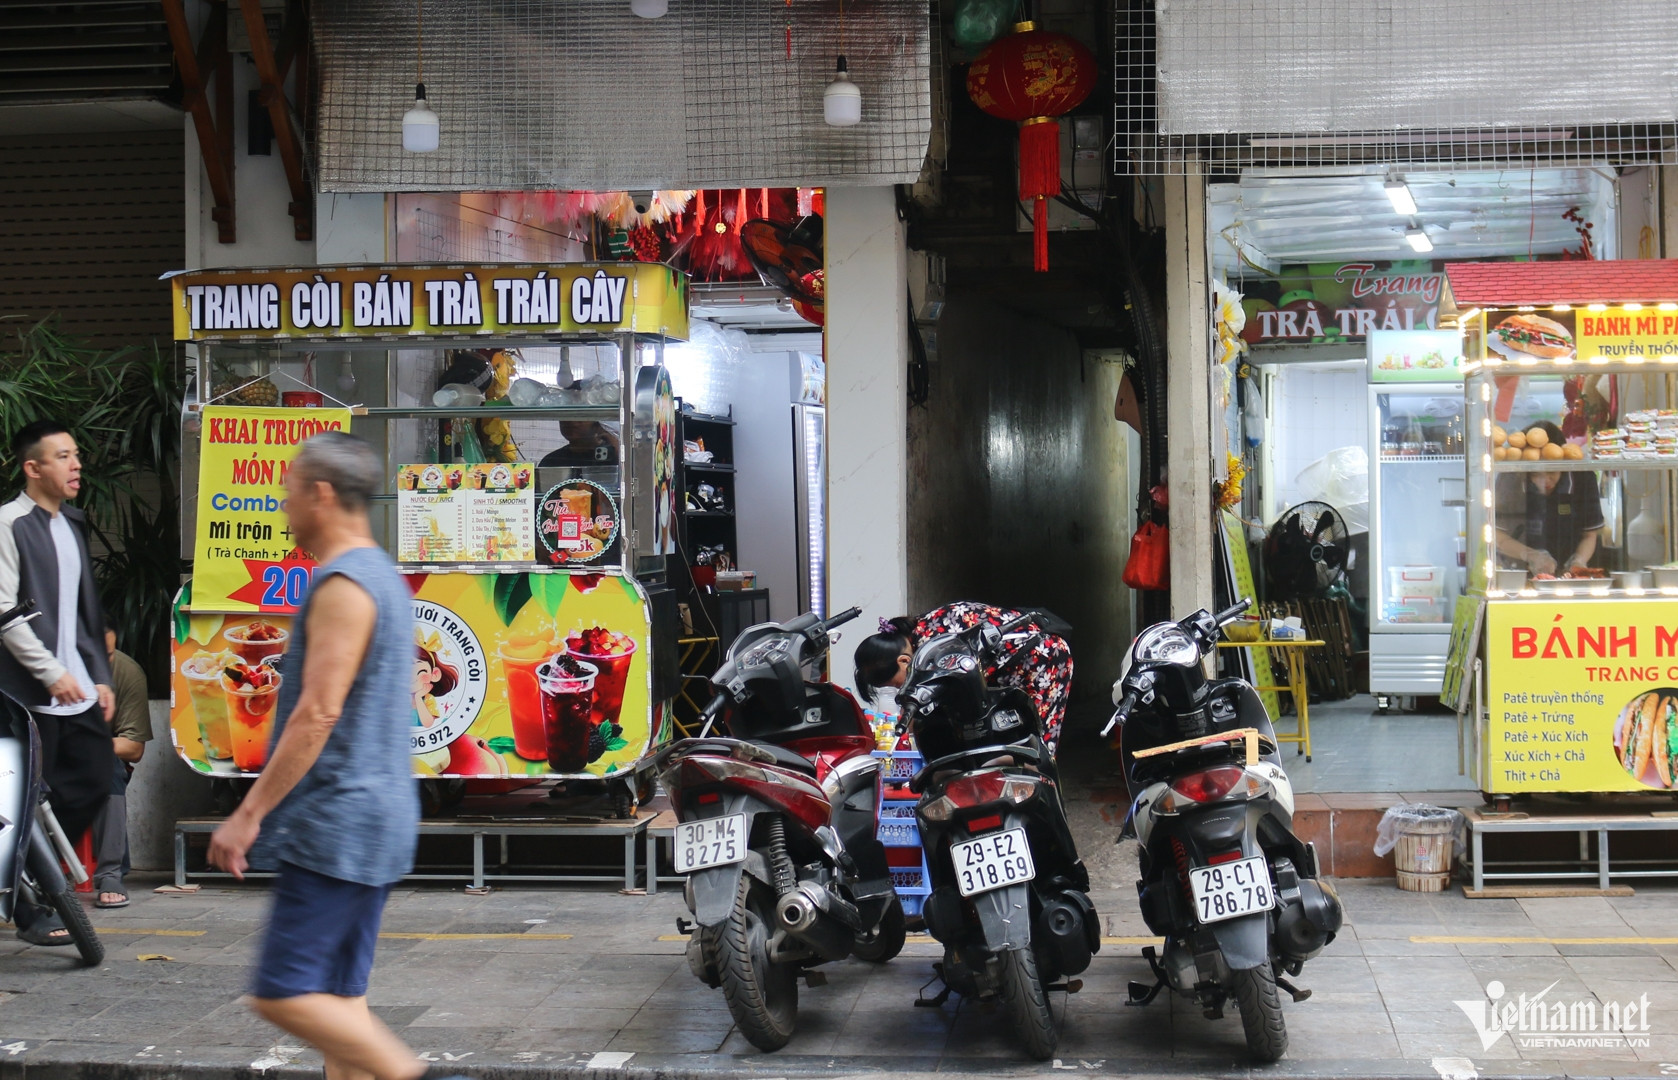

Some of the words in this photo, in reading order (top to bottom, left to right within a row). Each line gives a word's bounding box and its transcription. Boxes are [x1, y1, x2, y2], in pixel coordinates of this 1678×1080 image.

[1335, 263, 1442, 304] Trang
[186, 283, 279, 331] TRANG
[291, 274, 341, 329] CÒI
[353, 276, 412, 327] BÁN
[424, 272, 483, 326] TRÀ
[494, 271, 558, 325] TRÁI
[571, 269, 628, 324] CÂY
[1257, 301, 1325, 338] TRÀ
[1335, 299, 1416, 336] TRÁI
[1583, 312, 1631, 336] BÁNH
[1636, 311, 1657, 335] MÌ
[1598, 339, 1644, 356] TRUYỀN
[1648, 340, 1678, 355] THỐ
[209, 417, 258, 444] KHAI
[232, 451, 275, 485] MÓN
[209, 520, 230, 539] Mì
[237, 521, 272, 544] trộn
[234, 547, 269, 559] Chanh
[414, 605, 438, 623] ƯƠI
[441, 616, 475, 656] TRANG
[468, 658, 482, 682] CÒI
[1511, 613, 1637, 659] BÁNH
[1655, 625, 1678, 658] M
[1585, 666, 1659, 682] TRANG
[1503, 691, 1528, 704] Patê
[1531, 690, 1568, 706] truyền
[1571, 689, 1604, 705] thống
[1504, 711, 1528, 723] Patê
[1541, 711, 1575, 725] Trứng
[428, 725, 453, 745] 972
[1504, 730, 1529, 743] Patê
[1541, 730, 1562, 742] Xúc
[1565, 729, 1589, 742] Xích
[1504, 749, 1524, 762] Xúc
[1527, 749, 1551, 761] Xích
[1564, 749, 1585, 761] Chả
[1504, 769, 1526, 784] Thịt
[1539, 768, 1561, 781] Chả
[685, 817, 736, 845] 30-M4
[685, 840, 737, 867] 8275
[962, 834, 1017, 867] 29-E2
[962, 855, 1028, 896] 318.69
[1201, 862, 1256, 893] 29-C1
[1200, 885, 1268, 919] 786.78
